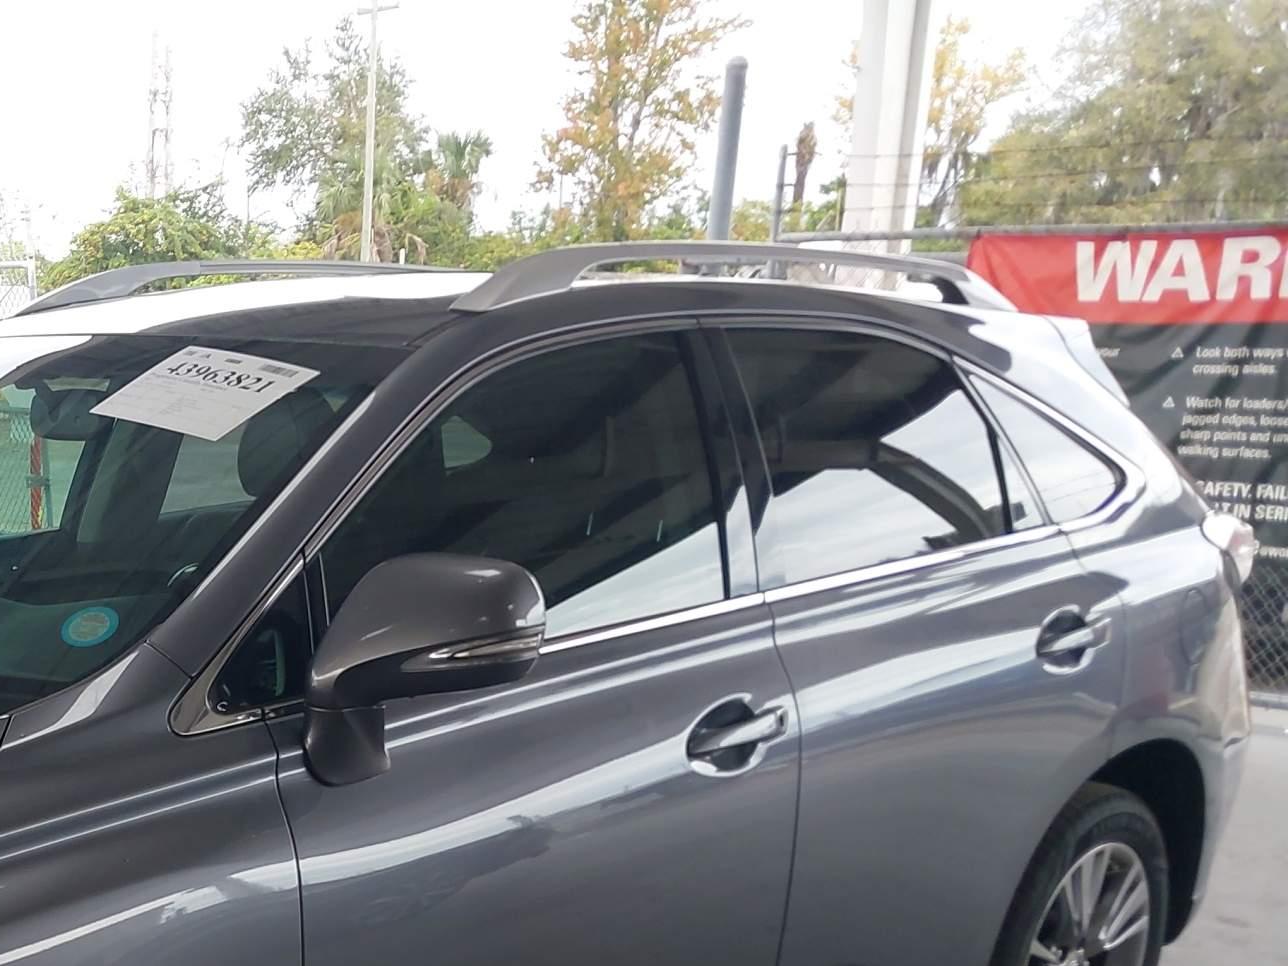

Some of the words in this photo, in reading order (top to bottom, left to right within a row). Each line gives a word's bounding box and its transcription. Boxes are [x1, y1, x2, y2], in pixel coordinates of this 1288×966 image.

[1196, 346, 1221, 358] Look
[1223, 346, 1249, 359] both
[1253, 348, 1284, 360] ways
[167, 362, 275, 393] 43963821
[1192, 364, 1239, 377] crossing
[1186, 396, 1222, 409] Watch
[1225, 397, 1241, 409] for
[1181, 413, 1220, 426] jagged
[1222, 414, 1258, 428] edges,
[1179, 429, 1211, 442] sharp
[1213, 431, 1248, 443] points
[1250, 432, 1271, 442] and
[1177, 446, 1219, 459] walking
[1222, 447, 1272, 459] surfaces.
